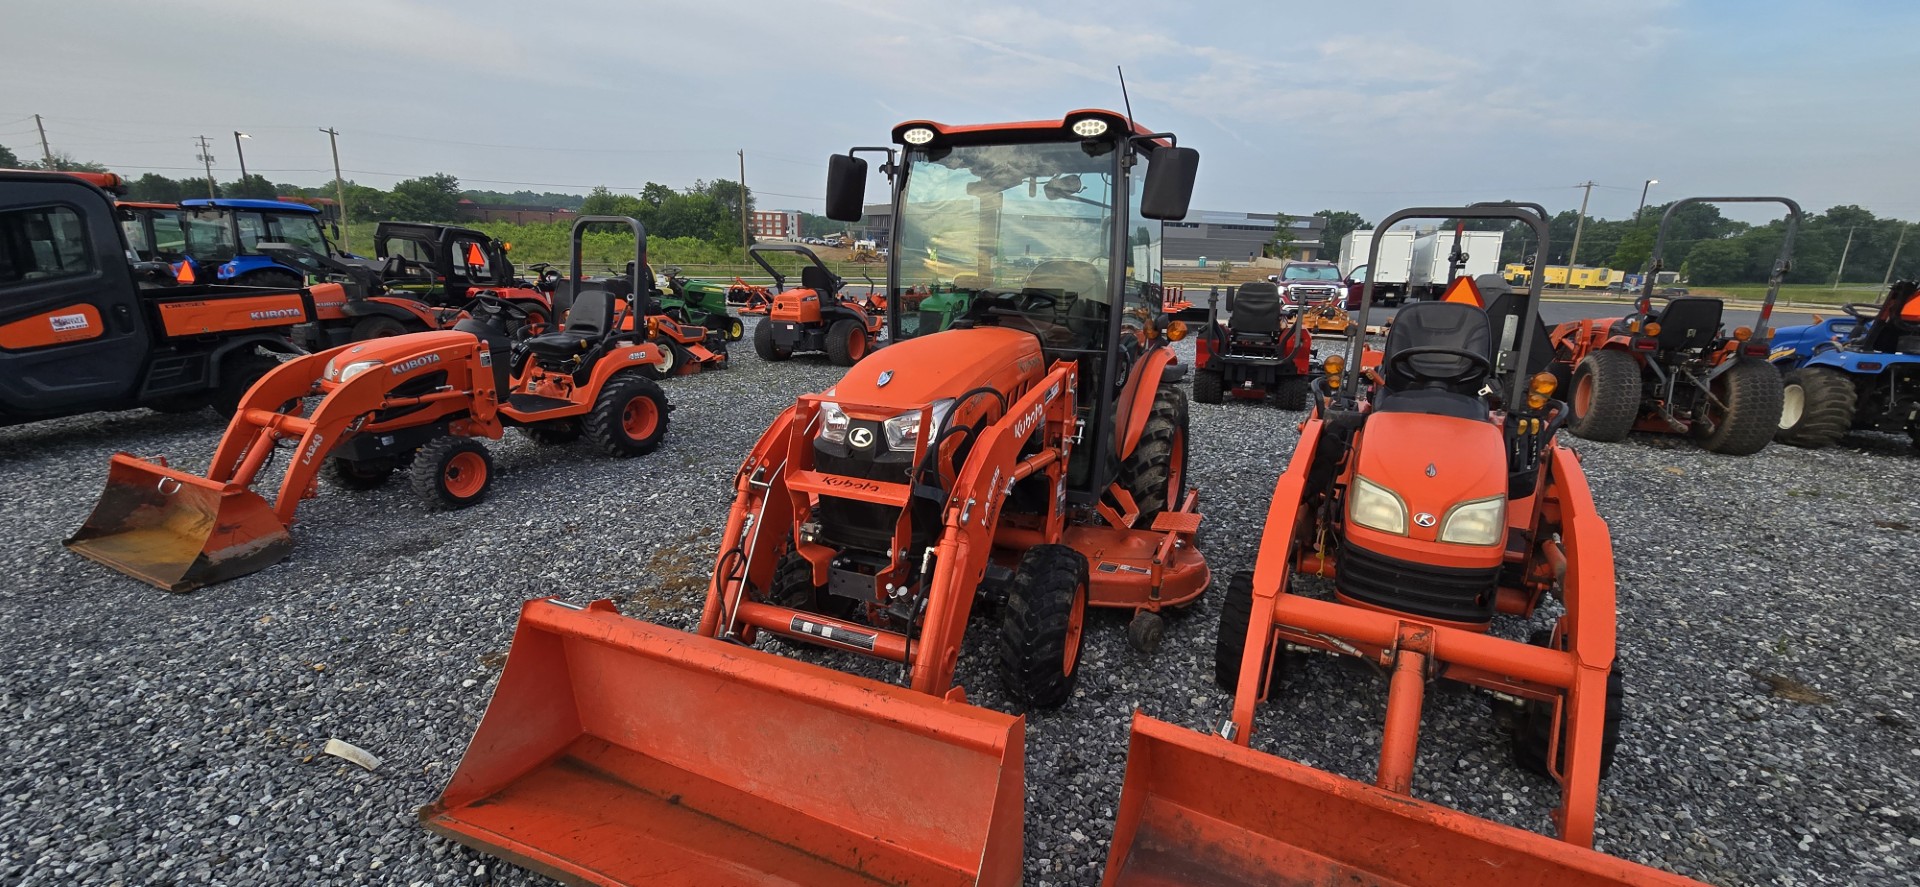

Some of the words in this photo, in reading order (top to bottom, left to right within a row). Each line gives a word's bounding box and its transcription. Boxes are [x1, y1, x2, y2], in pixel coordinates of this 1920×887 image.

[250, 308, 301, 319] KUBOTA
[391, 353, 440, 375] KUBOTA
[1014, 403, 1043, 438] Kubota
[303, 434, 323, 465] LA243
[822, 476, 880, 492] Kubota
